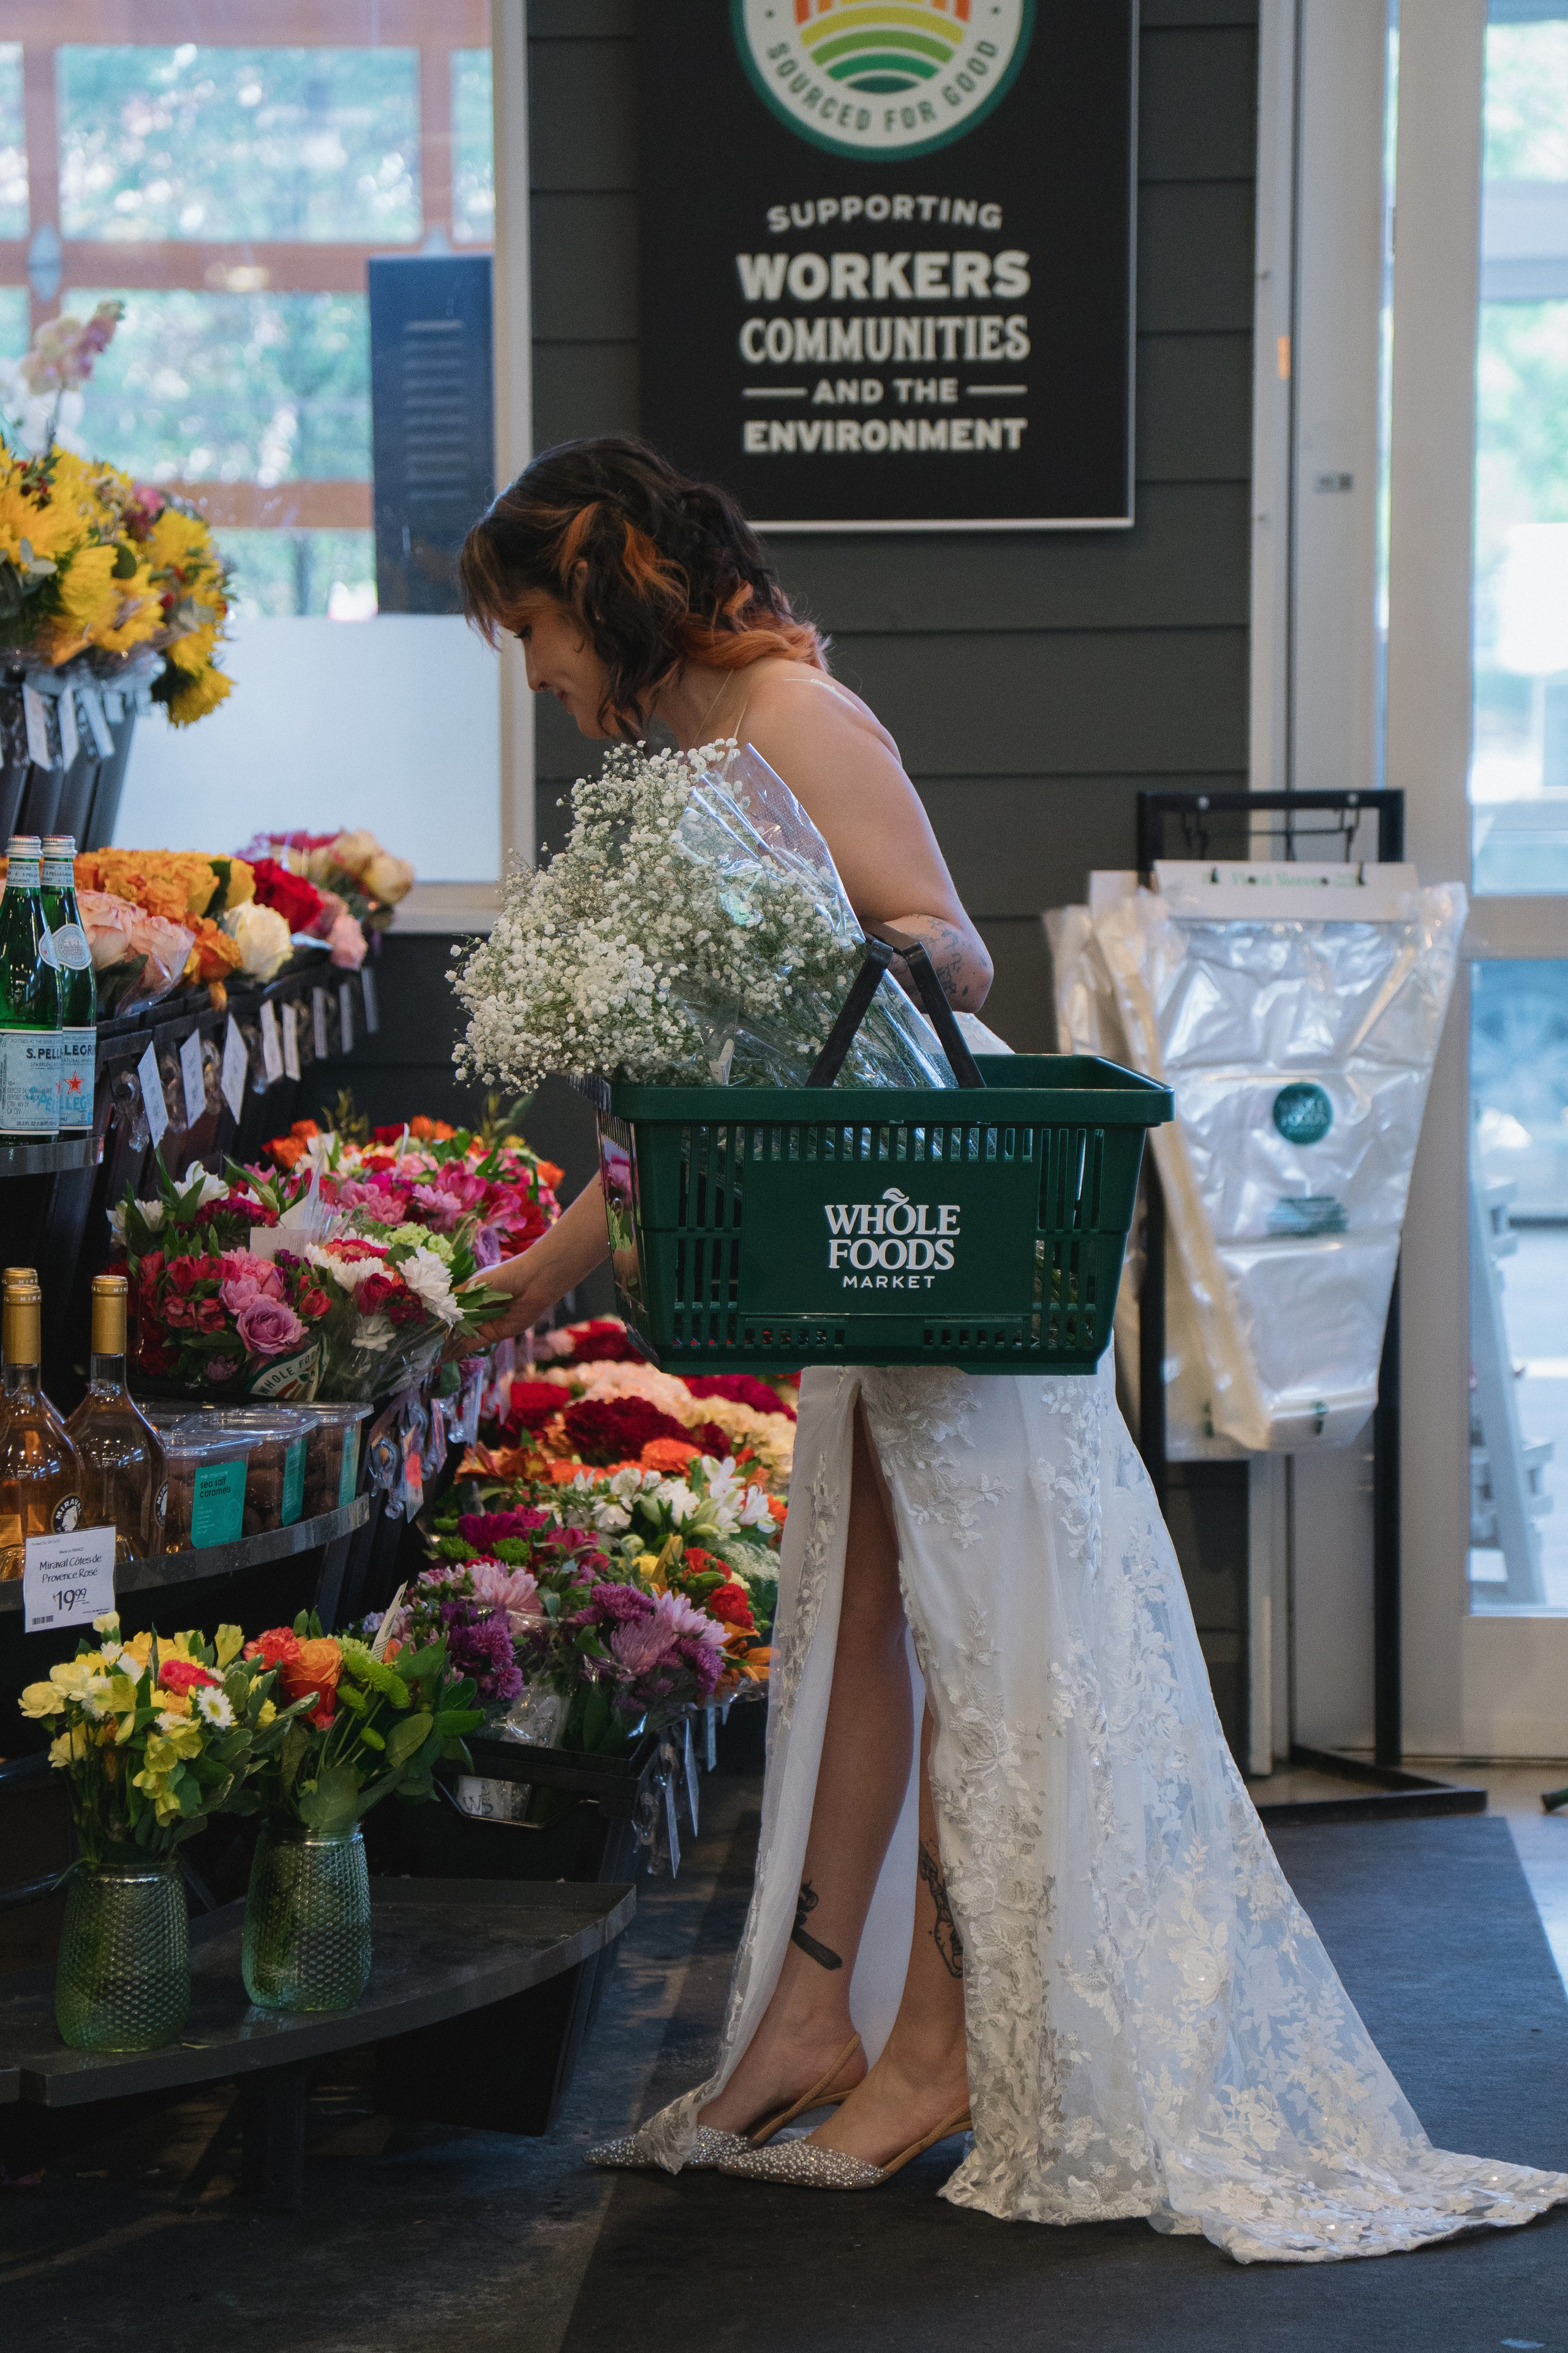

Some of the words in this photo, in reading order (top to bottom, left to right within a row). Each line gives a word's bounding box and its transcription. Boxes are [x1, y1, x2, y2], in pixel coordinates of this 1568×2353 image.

[766, 41, 872, 132] SOURCED
[884, 100, 937, 133] FOR
[942, 39, 999, 107] GOOD
[767, 194, 1003, 232] SUPPORTING
[736, 250, 1031, 301] WORKERS
[739, 315, 1031, 363] COMMUNITIES
[812, 379, 884, 404] AND
[893, 377, 959, 404] THE
[743, 417, 1028, 454] ENVIRONMENT
[824, 1201, 961, 1236] WHOLE
[828, 1238, 955, 1271] FOODS
[842, 1275, 936, 1288] MARKET
[258, 1367, 295, 1395] WHOLE
[199, 1485, 232, 1498] caramels
[200, 1481, 213, 1489] sea
[214, 1476, 227, 1487] salt
[55, 1498, 82, 1520] MIRAVAL
[39, 1558, 69, 1571] Miraval
[69, 1557, 92, 1567] Côtes
[92, 1554, 102, 1563] de
[42, 1572, 78, 1584] Provence
[78, 1567, 98, 1579] Rosé
